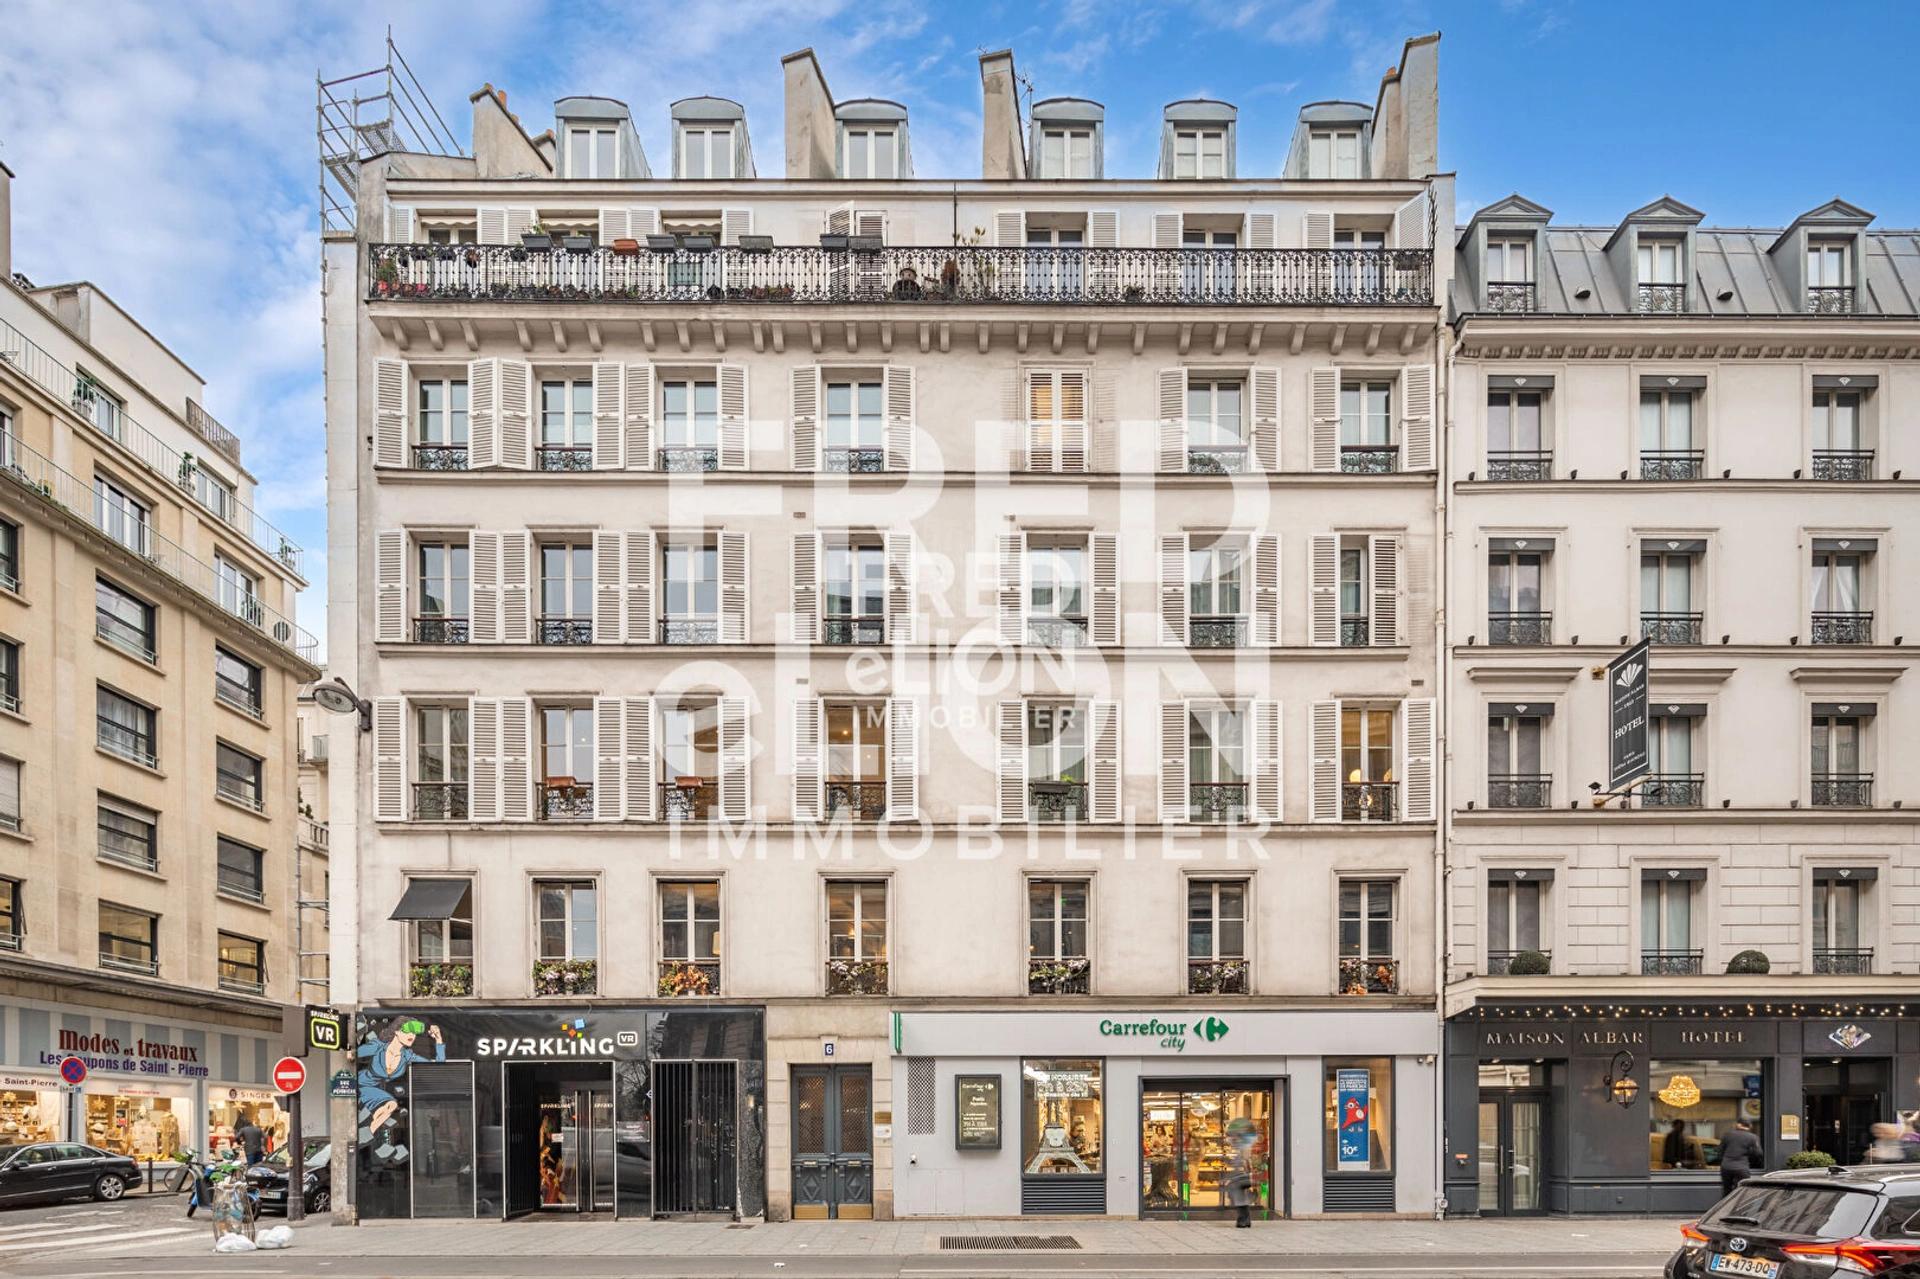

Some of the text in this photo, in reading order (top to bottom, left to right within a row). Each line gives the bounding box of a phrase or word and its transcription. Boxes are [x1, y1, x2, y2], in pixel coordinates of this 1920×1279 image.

[1614, 716, 1645, 739] HOTEL
[315, 1025, 335, 1042] VR
[1100, 1018, 1187, 1036] Carrefour
[1160, 1036, 1186, 1052] city
[1486, 1031, 1746, 1044] MAISON ALBAR HOTEL
[124, 1047, 134, 1057] et
[137, 1038, 198, 1063] travaux
[826, 1045, 833, 1054] 6
[39, 1051, 62, 1066] Les
[123, 1058, 136, 1072] de
[140, 1060, 168, 1075] Saint
[178, 1063, 209, 1077] Pierre
[240, 1090, 271, 1099] SINGER
